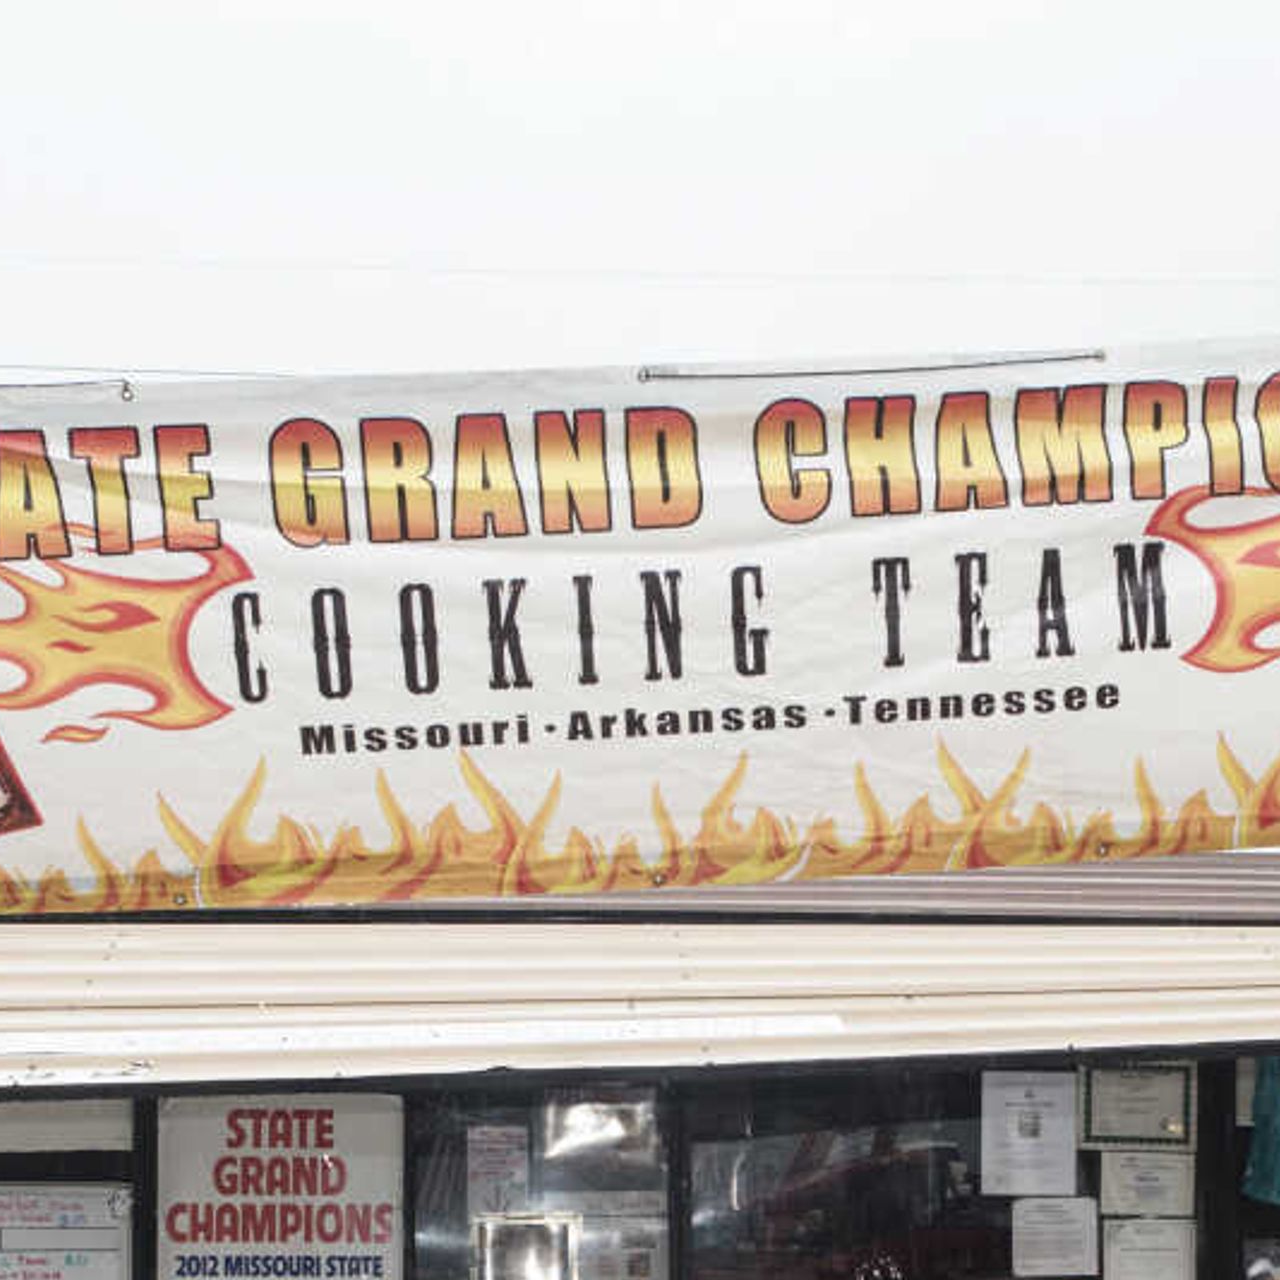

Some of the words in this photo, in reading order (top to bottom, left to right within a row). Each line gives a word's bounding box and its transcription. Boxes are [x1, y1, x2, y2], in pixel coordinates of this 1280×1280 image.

[267, 405, 704, 548] GRAND
[231, 564, 768, 706] COOKING
[872, 540, 1173, 668] TEAM
[300, 711, 534, 757] Missouri
[567, 696, 808, 744] Arkansas
[841, 679, 1124, 728] Tennessee
[225, 1108, 335, 1149] STATE
[212, 1155, 349, 1197] GRAND
[165, 1203, 394, 1245] CHAMPIONS
[174, 1254, 220, 1278] 2012
[223, 1254, 322, 1278] MISSOURI
[325, 1254, 384, 1278] STATE
